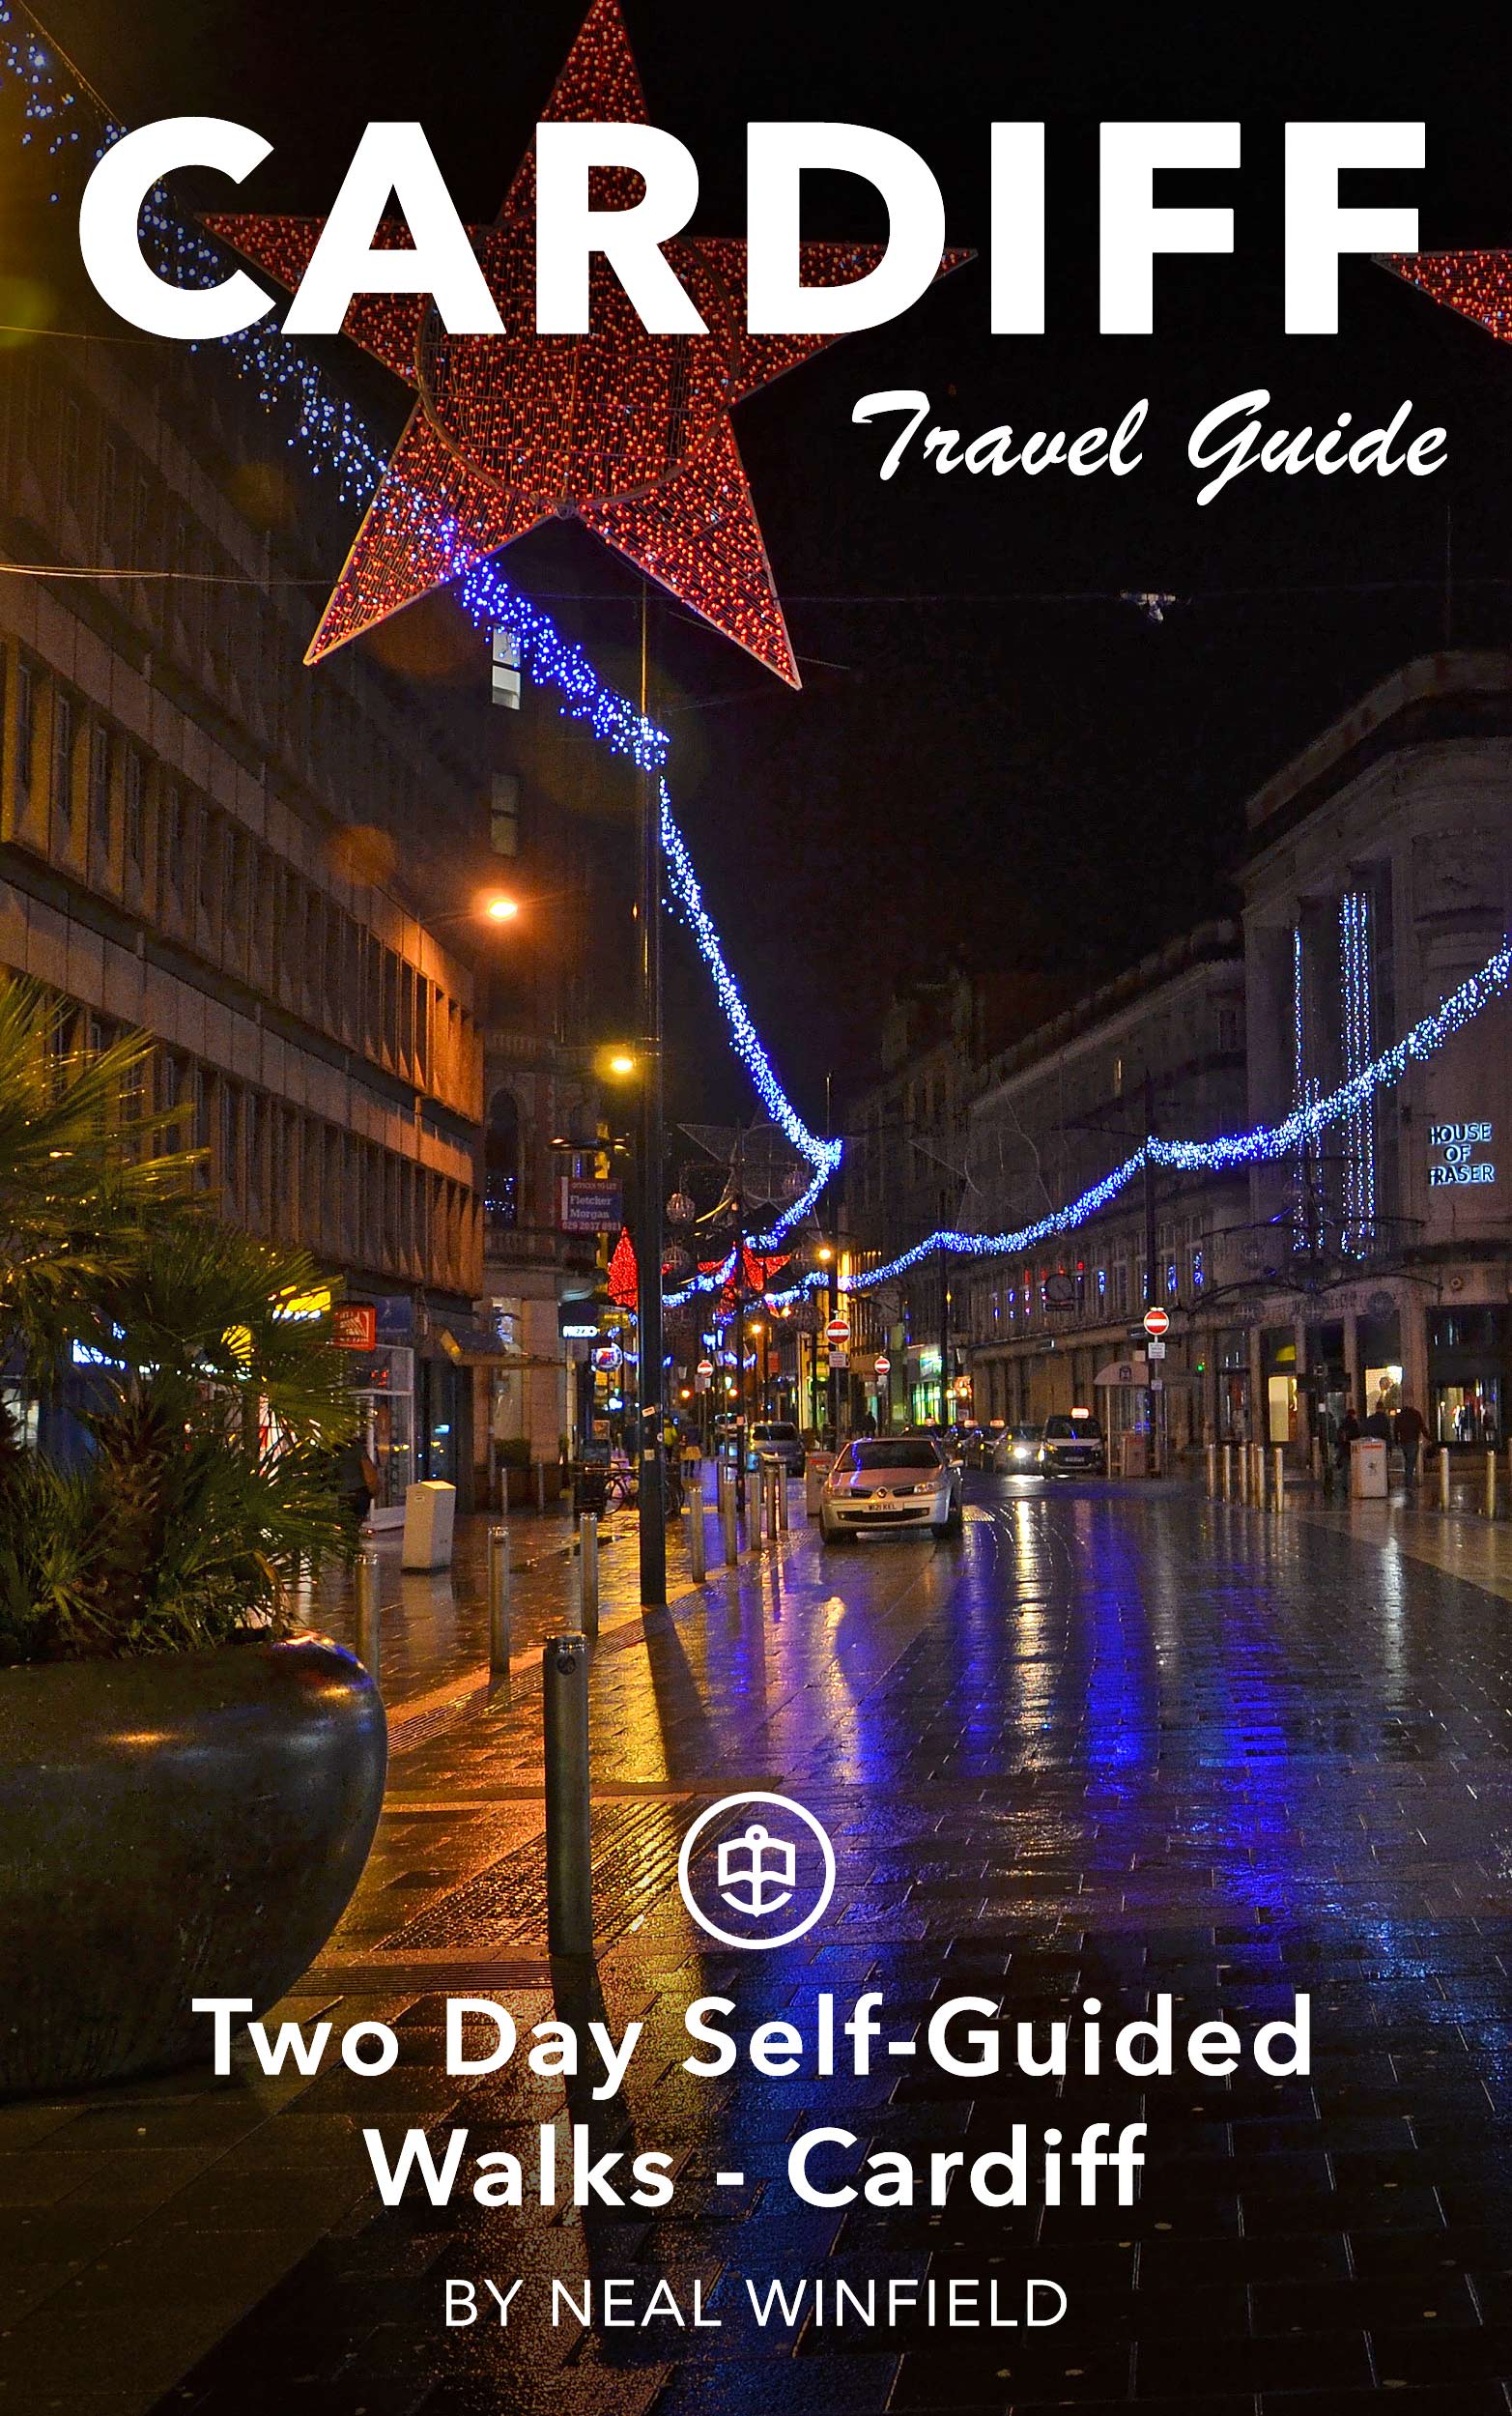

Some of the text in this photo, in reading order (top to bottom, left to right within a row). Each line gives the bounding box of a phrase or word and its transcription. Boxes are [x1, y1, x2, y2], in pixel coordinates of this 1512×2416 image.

[1428, 1123, 1493, 1145] HOUSE
[1443, 1144, 1471, 1165] OF
[1428, 1164, 1495, 1186] FRASER
[570, 1194, 612, 1205] Fletcher
[570, 1208, 611, 1220] Morgan
